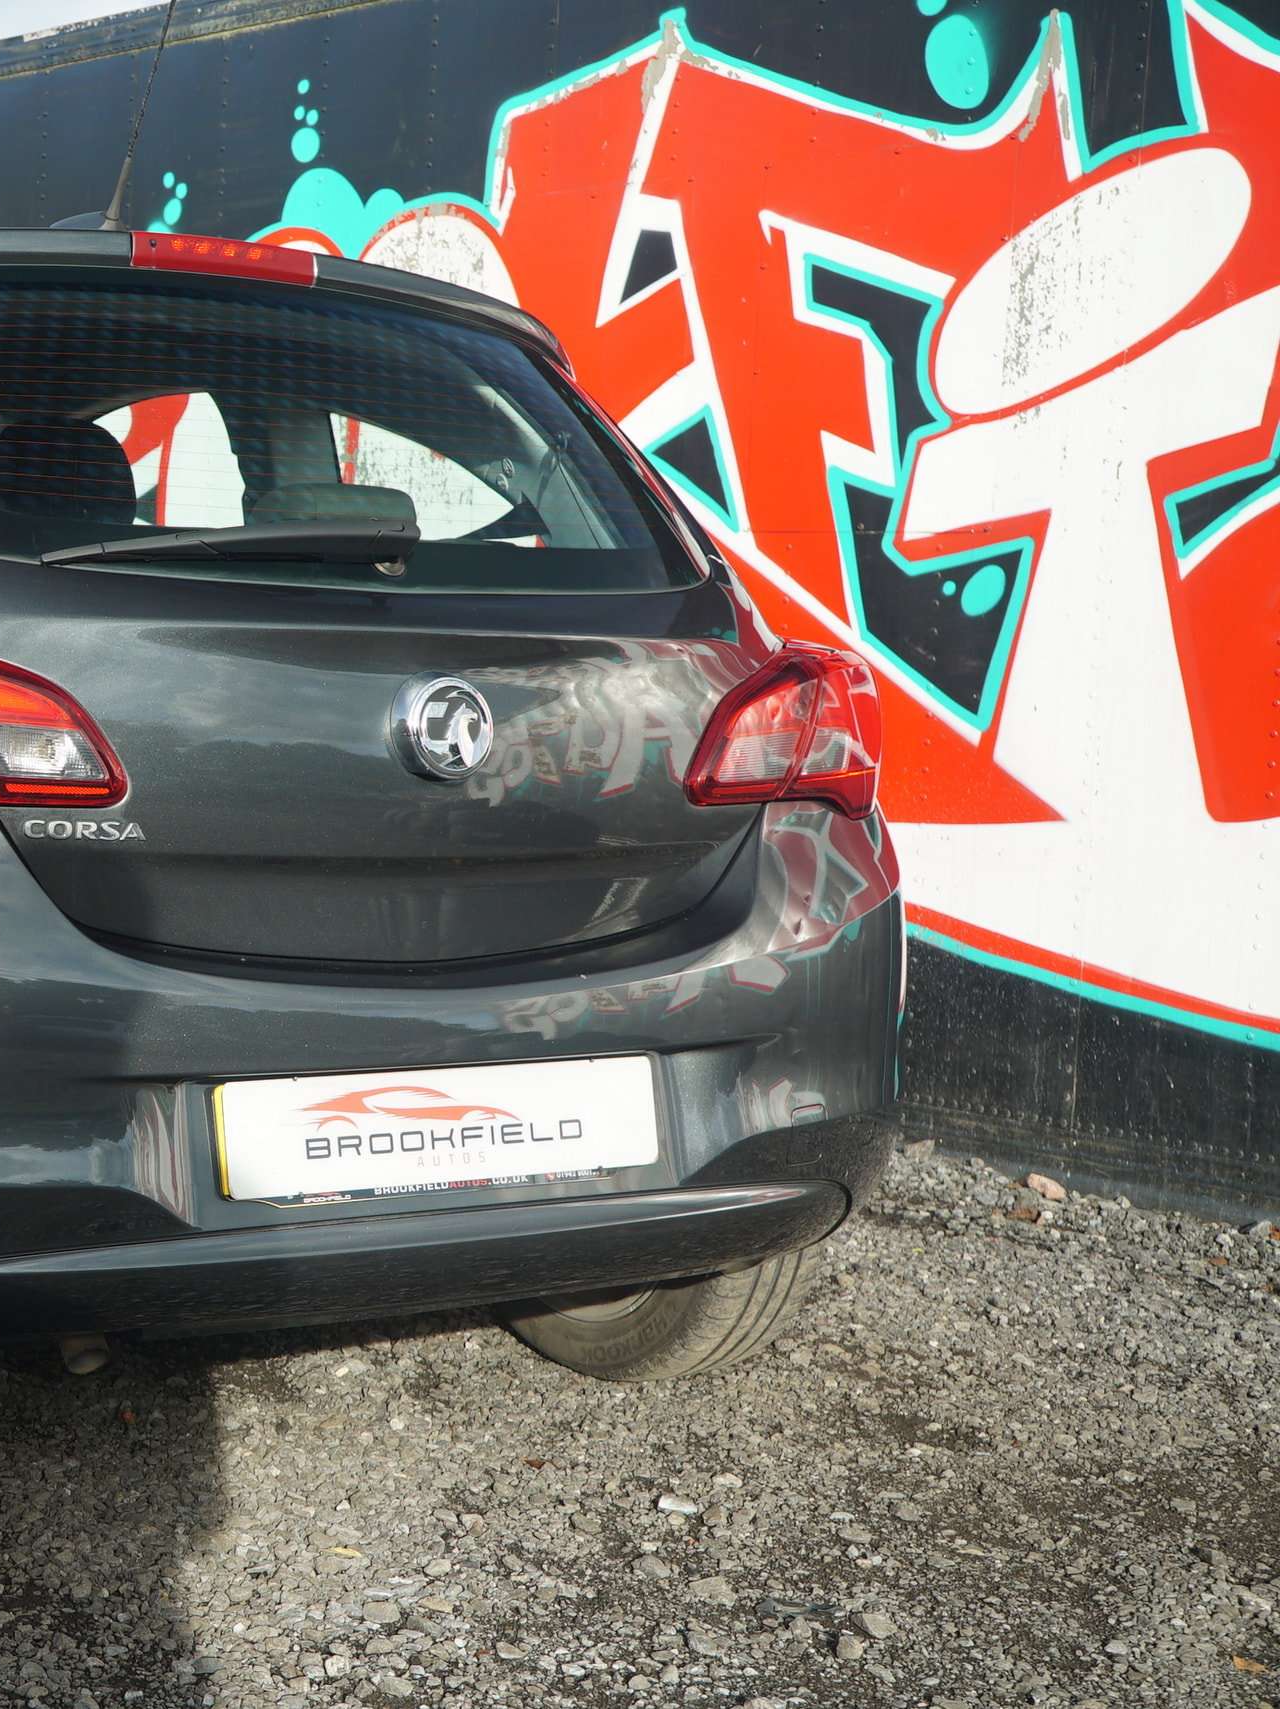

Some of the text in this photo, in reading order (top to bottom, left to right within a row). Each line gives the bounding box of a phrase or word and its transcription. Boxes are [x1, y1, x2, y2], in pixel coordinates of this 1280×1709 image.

[24, 819, 146, 841] CORSA
[305, 1119, 582, 1160] BROOKFIELD
[417, 1151, 486, 1167] AUTOS
